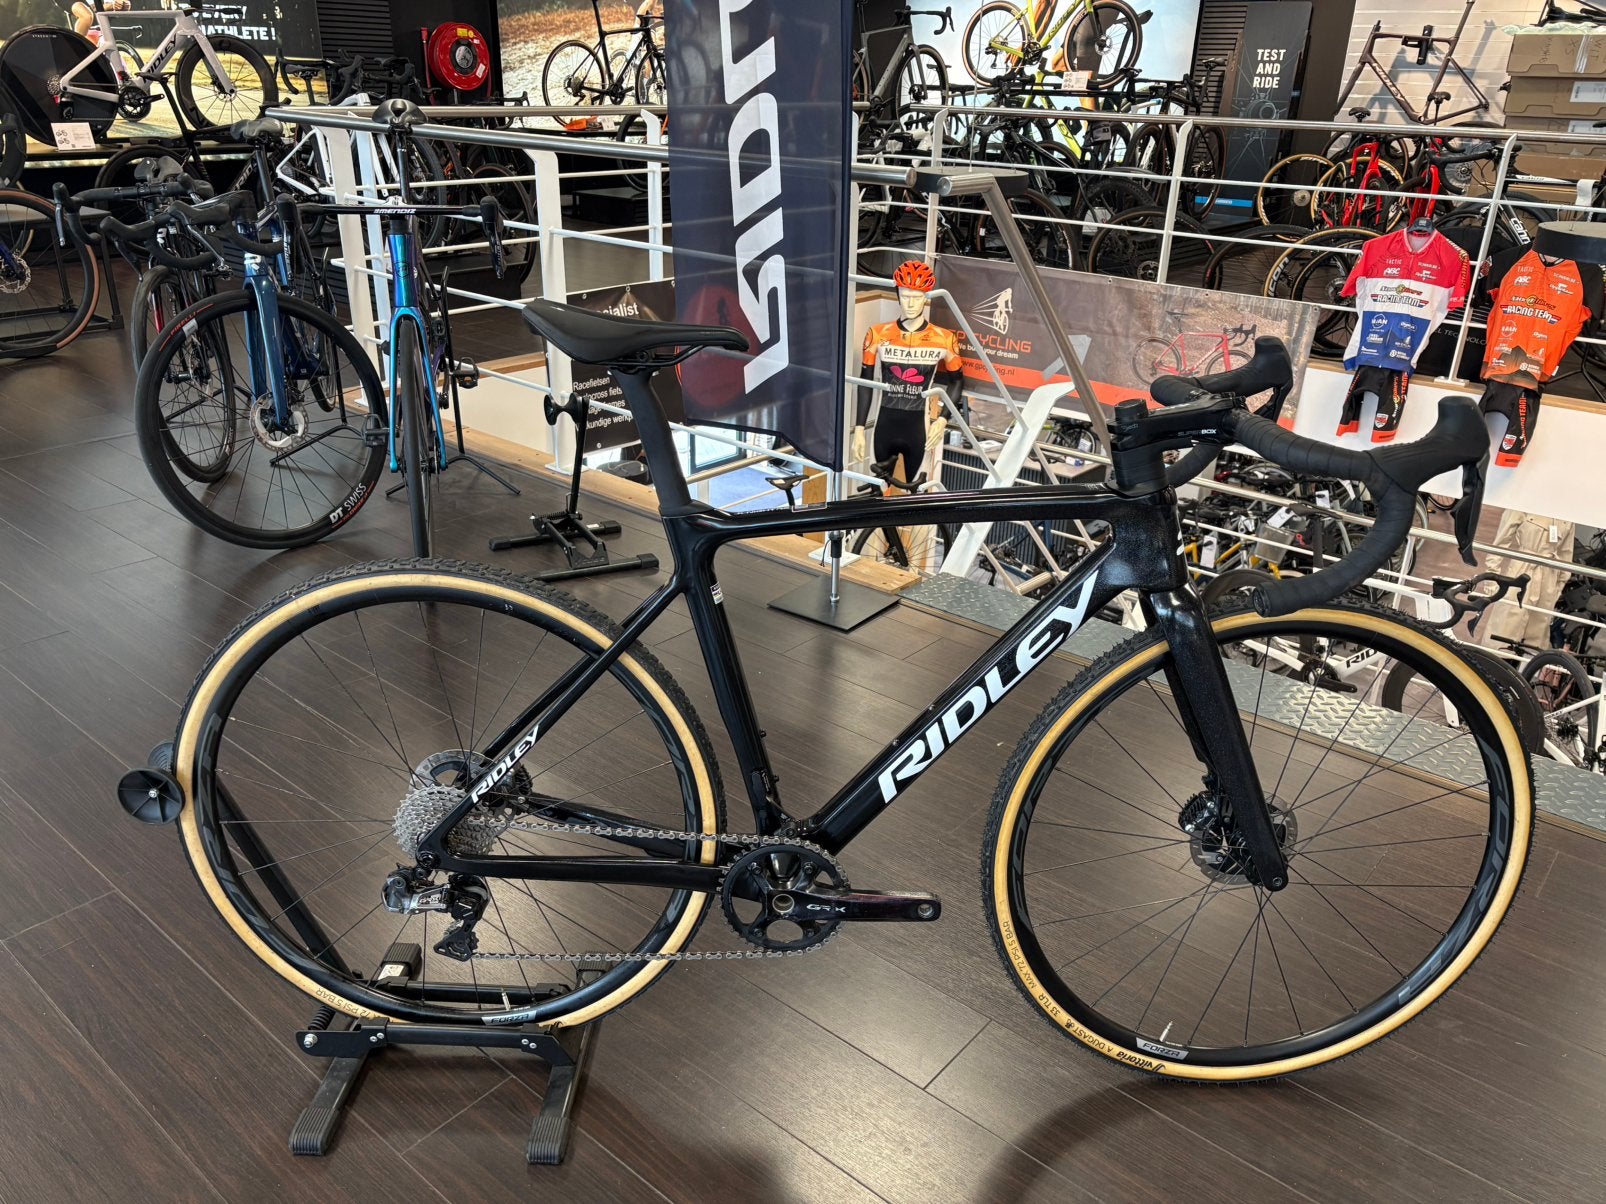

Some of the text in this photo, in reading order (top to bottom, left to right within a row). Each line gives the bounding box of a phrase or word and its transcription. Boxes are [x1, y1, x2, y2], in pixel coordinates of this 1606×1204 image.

[1257, 49, 1286, 61] TEST
[1256, 63, 1281, 75] AND
[1252, 77, 1280, 89] RIDE
[1506, 304, 1534, 317] RACING
[884, 347, 941, 359] METALURA
[997, 350, 1018, 360] dream
[573, 377, 611, 391] Racefietsen
[330, 507, 343, 523] DT
[344, 483, 367, 511] SWISS
[878, 570, 1099, 804] RIDLEY
[471, 725, 539, 804] RIDLEY
[806, 903, 847, 913] GRX
[1002, 920, 1014, 940] BAR
[1023, 969, 1037, 989] MAX
[315, 987, 336, 1004] BAR
[343, 1002, 359, 1015] PSI
[1050, 1006, 1061, 1017] 33
[490, 1013, 530, 1024] FORZA
[1072, 1027, 1106, 1050] DUGAST
[1142, 1042, 1182, 1058] FORZA
[1115, 1050, 1154, 1069] vittoria
